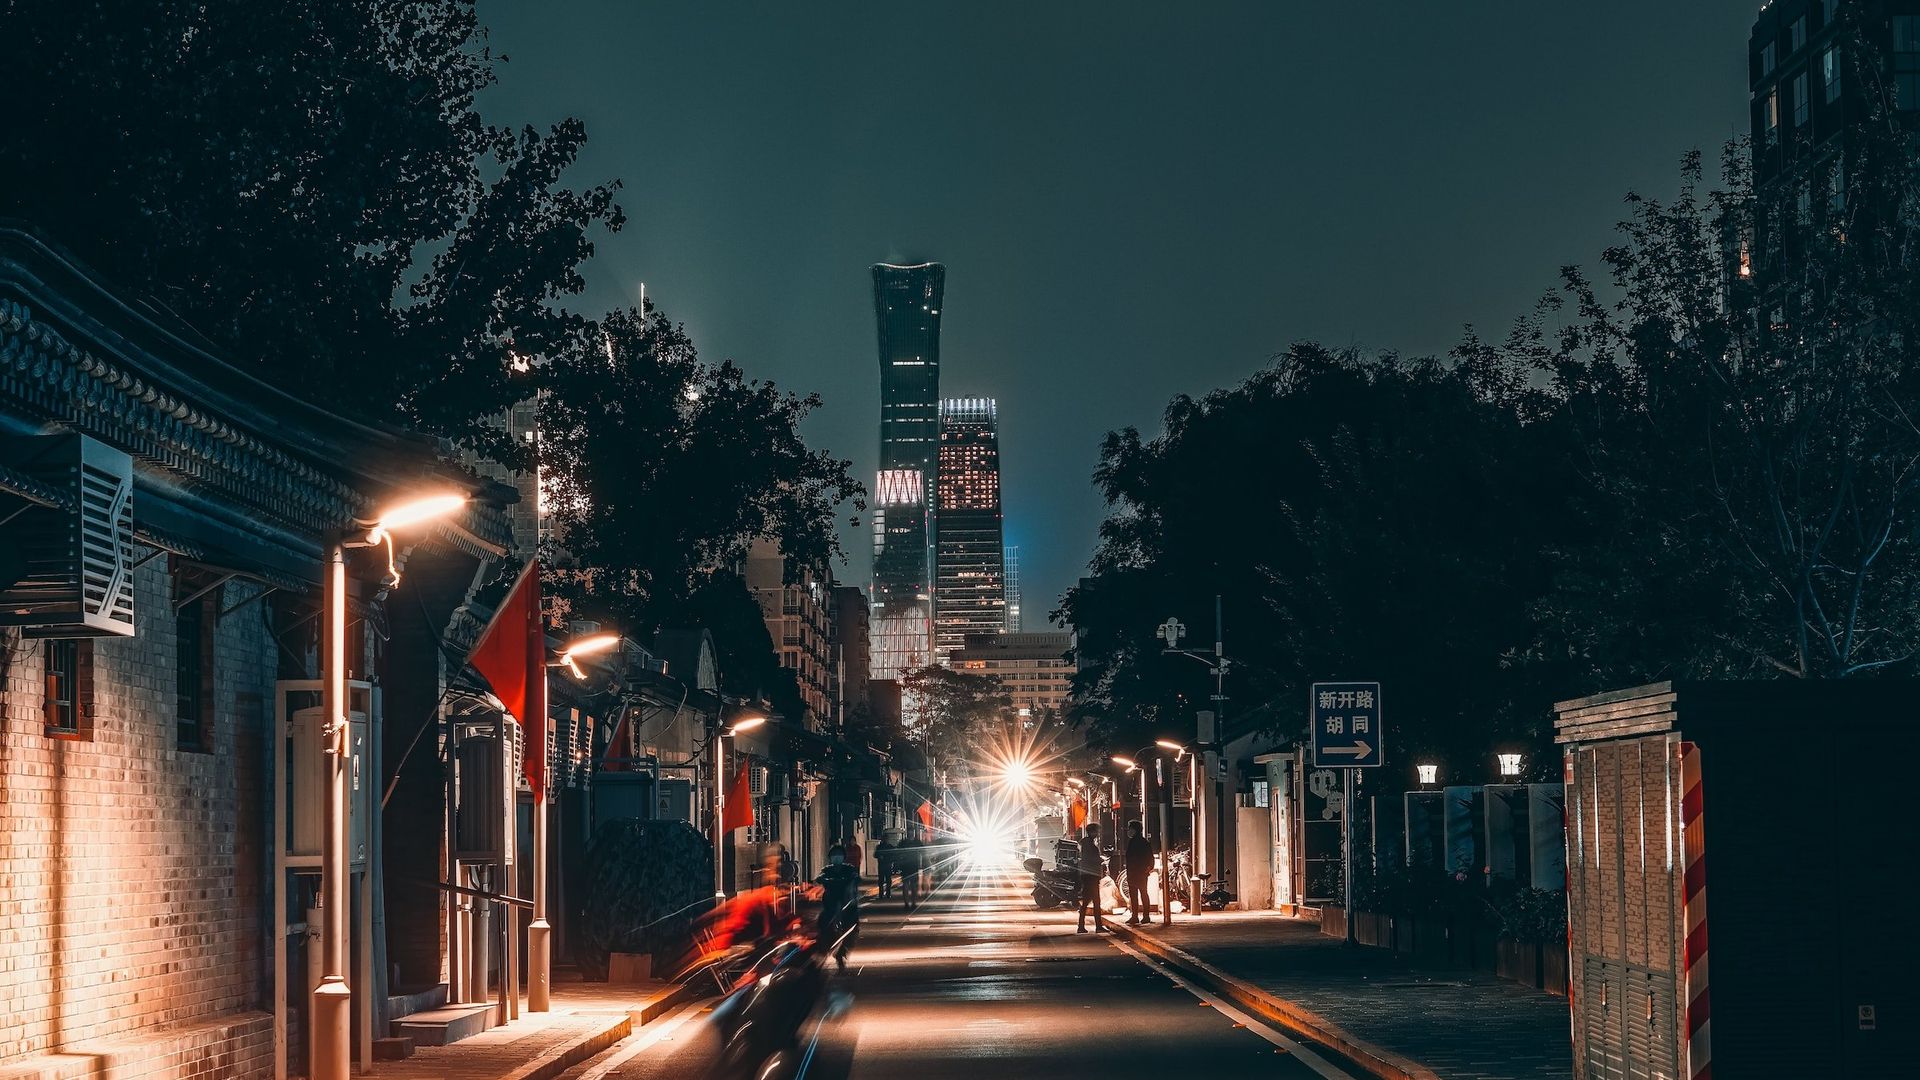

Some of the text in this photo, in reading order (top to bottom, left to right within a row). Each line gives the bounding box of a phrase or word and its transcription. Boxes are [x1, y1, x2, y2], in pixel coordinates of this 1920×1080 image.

[1319, 690, 1374, 709] 新开路
[1326, 716, 1369, 734] 胡同
